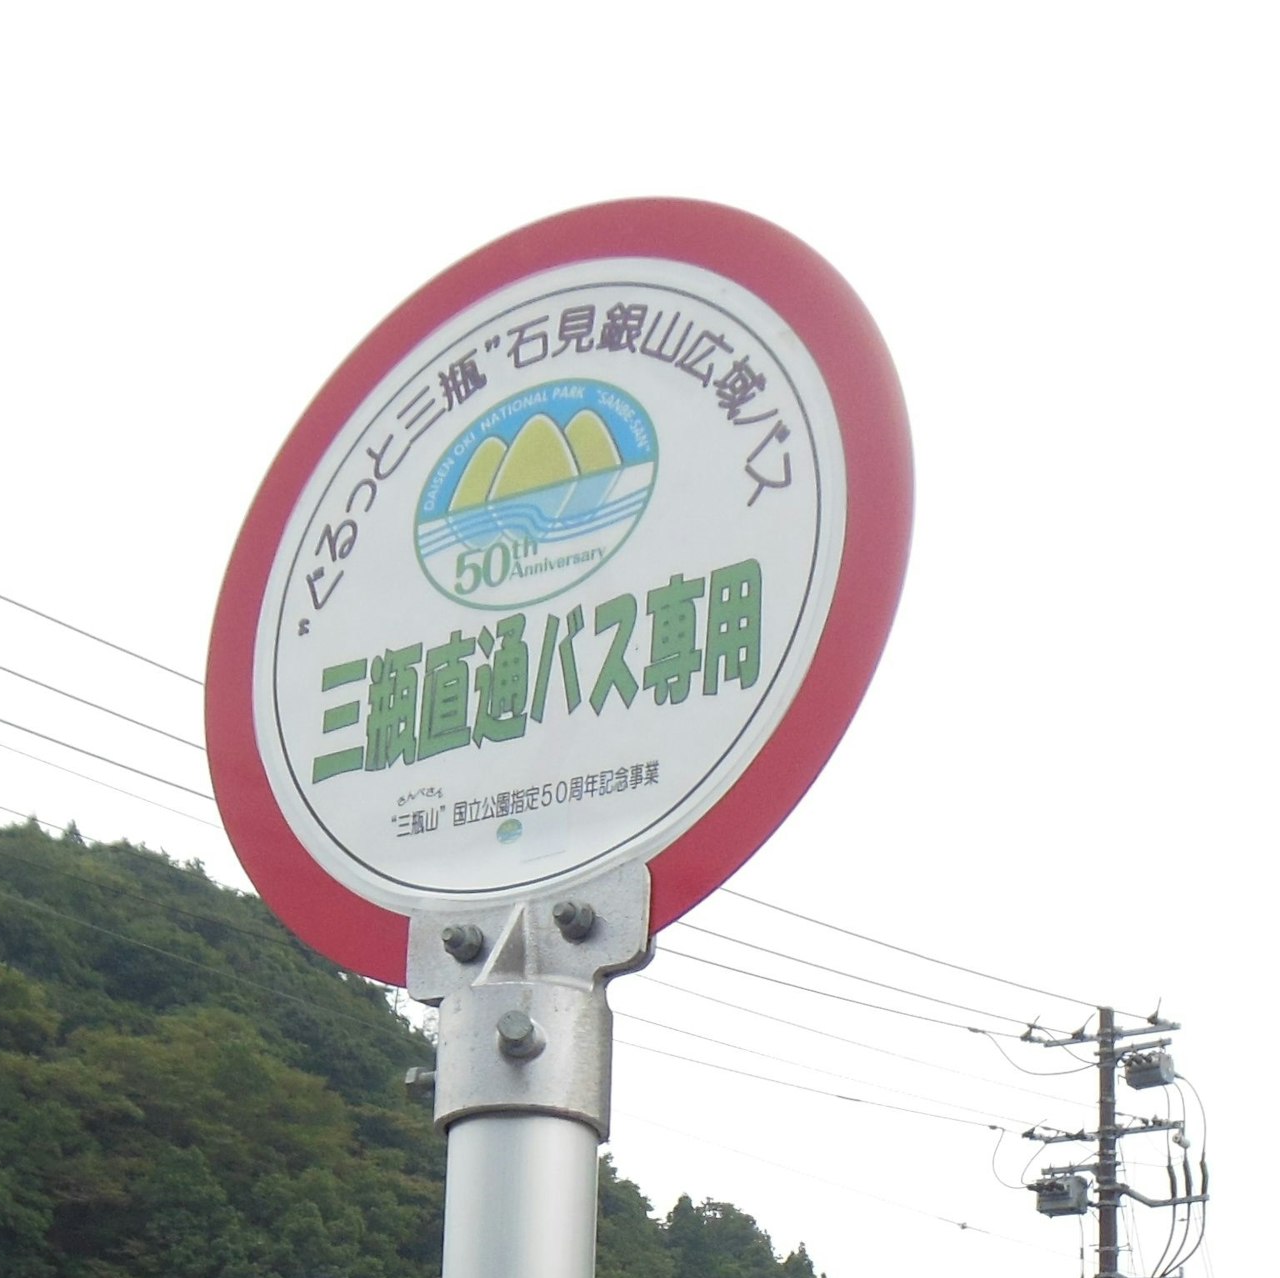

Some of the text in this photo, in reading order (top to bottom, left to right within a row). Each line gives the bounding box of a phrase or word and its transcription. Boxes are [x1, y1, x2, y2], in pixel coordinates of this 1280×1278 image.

[423, 458, 455, 512] DAISEN
[453, 431, 476, 456] OKI
[479, 391, 548, 432] NATIONAL
[551, 385, 586, 400] PARK
[508, 546, 607, 580] Anniversary
[312, 558, 762, 784] 三瓶直通バス専用
